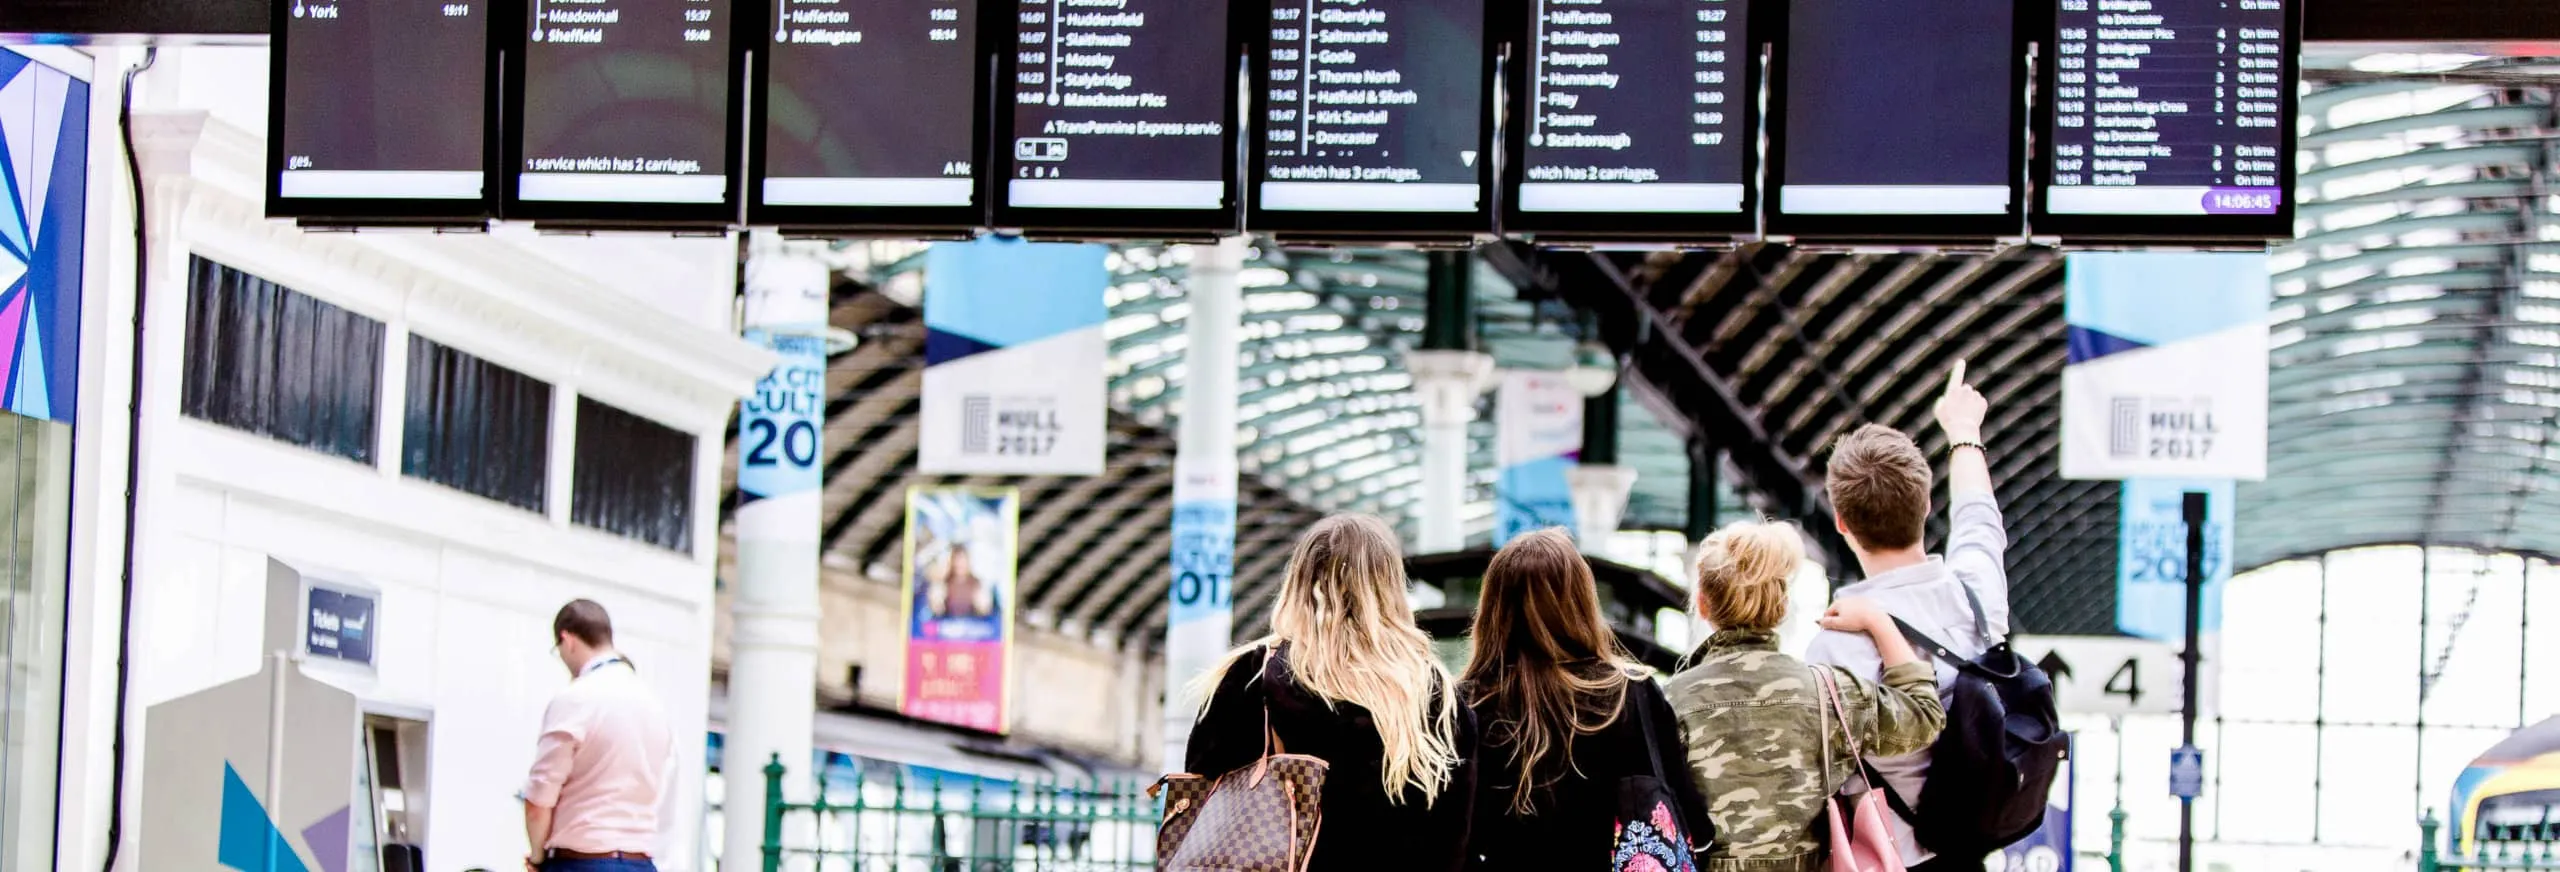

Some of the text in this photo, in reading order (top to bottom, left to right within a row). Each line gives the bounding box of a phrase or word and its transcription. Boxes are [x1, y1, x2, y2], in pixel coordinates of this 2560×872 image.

[310, 4, 337, 18] York
[2240, 0, 2280, 9] On time
[549, 9, 618, 23] Meadowhall
[793, 9, 849, 23] Nafferton
[1067, 12, 1144, 26] Huddersfield
[1318, 9, 1385, 25] Gilberdyke
[1549, 10, 1612, 24] Nafferton
[2113, 14, 2164, 25] Doncaster
[548, 28, 602, 43] Sheffield
[792, 29, 862, 46] Bridlington
[1064, 32, 1131, 46] Slaithwaite
[1320, 29, 1388, 43] Saltmarshe
[1551, 31, 1619, 48] Bridlington
[2098, 28, 2153, 39] Manchester
[2239, 28, 2279, 39] On time
[2097, 43, 2150, 56] Bridlington
[2218, 42, 2225, 53] 7
[2239, 43, 2279, 53] On time
[1063, 53, 1114, 69] Mossley
[1316, 50, 1356, 63] Goole
[1548, 52, 1608, 68] Bempton
[2096, 57, 2139, 68] Sheffield
[2238, 57, 2278, 68] On time
[1062, 72, 1132, 90] Stalybridge
[1316, 69, 1400, 83] Thorne North
[1549, 72, 1619, 88] Hunmanby
[2096, 72, 2119, 83] York
[2238, 72, 2278, 83] On time
[1317, 90, 1366, 104] Hatfield
[1366, 90, 1378, 104] &
[2096, 86, 2138, 98] Sheffield
[2237, 87, 2277, 97] On time
[1064, 92, 1167, 107] Manchester Picc
[1549, 92, 1578, 109] Filey
[2216, 101, 2223, 112] 2
[2237, 101, 2277, 112] On time
[2095, 101, 2188, 114] London Kings Cross
[1317, 110, 1388, 124] Kirk Sandall
[1546, 113, 1597, 126] Seamer
[2095, 116, 2156, 129] Scarborough
[2236, 116, 2276, 127] On time
[1044, 120, 1056, 133] A
[1055, 120, 1136, 134] TransPennine
[1137, 121, 1184, 137] Express
[1314, 131, 1379, 144] Doncaster
[1547, 133, 1631, 150] Scarborough
[2110, 130, 2160, 142] Doncaster
[2094, 145, 2150, 156] Manchester
[2236, 145, 2276, 156] On time
[535, 156, 576, 170] service
[577, 156, 611, 171] which
[613, 157, 634, 171] has
[635, 157, 644, 171] 2
[645, 158, 700, 175] carriages.
[943, 162, 954, 175] A
[1020, 167, 1059, 177] C B A
[2093, 159, 2146, 173] Bridlington
[2235, 160, 2275, 171] On time
[1290, 165, 1327, 179] which
[1328, 165, 1351, 179] has
[1352, 166, 1362, 179] 3
[1362, 166, 1421, 182] carriages.
[1563, 166, 1588, 180] has
[1588, 166, 1599, 180] 2
[1598, 166, 1661, 184] carriages.
[2093, 174, 2136, 185] Sheffield
[2235, 175, 2274, 185] On time
[2214, 194, 2272, 209] 14:06:45
[2149, 439, 2213, 460] 2017
[2132, 556, 2222, 583] 207
[2104, 658, 2146, 705] 4
